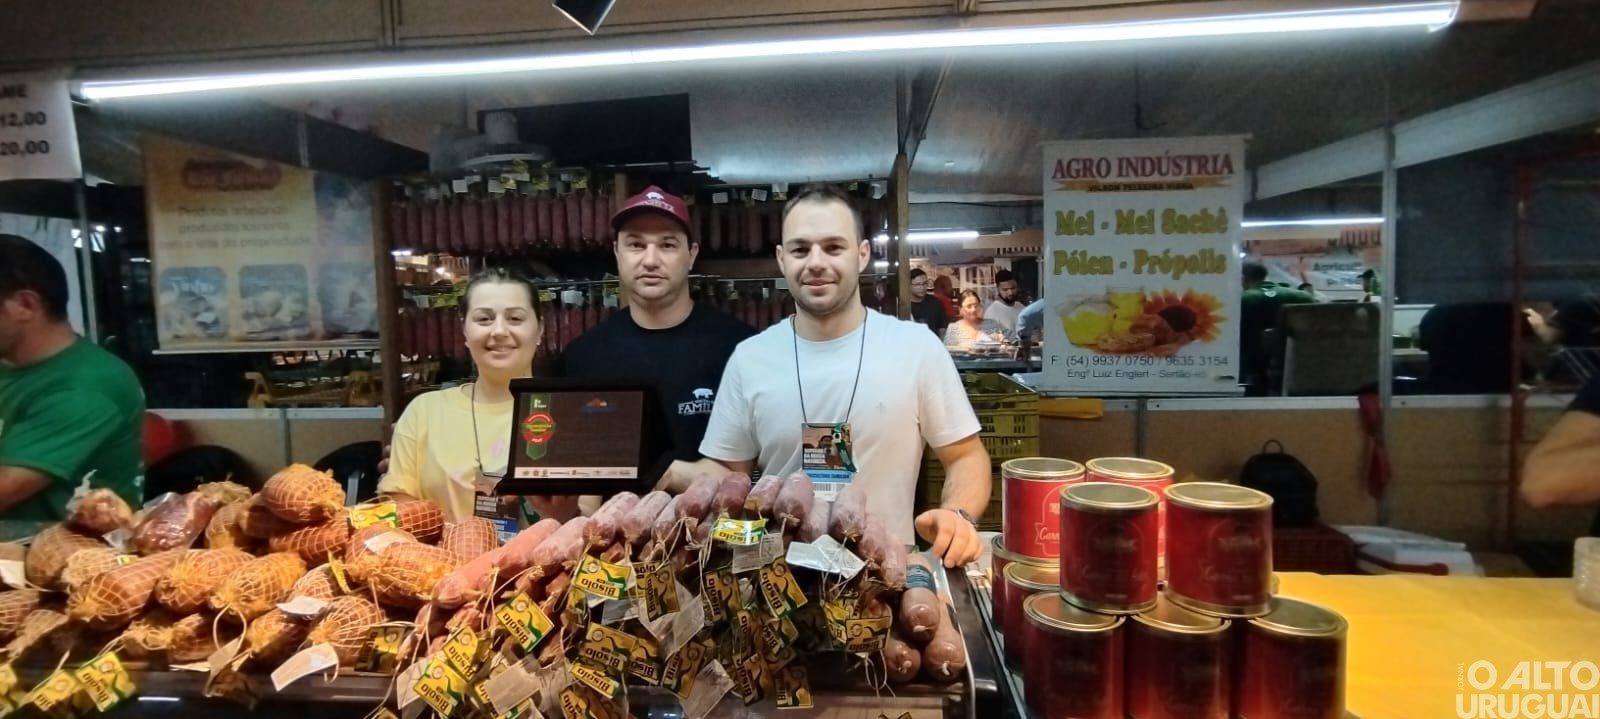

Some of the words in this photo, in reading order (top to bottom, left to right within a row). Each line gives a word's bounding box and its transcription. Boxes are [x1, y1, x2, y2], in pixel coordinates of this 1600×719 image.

[1052, 157, 1111, 180] AGRO
[1117, 150, 1234, 178] INDÚSTRIA
[1055, 210, 1095, 236] Mel
[1114, 209, 1156, 235] Mel
[1161, 206, 1229, 234] Sachê
[1053, 249, 1114, 275] Pólen
[1133, 248, 1227, 279] Própolis
[1066, 356, 1089, 367] (54)
[1092, 355, 1121, 366] 9937
[1125, 355, 1154, 366] 0750
[1199, 355, 1229, 366] 3154
[580, 578, 617, 597] Bisolo
[761, 571, 783, 610] Bisolo
[502, 612, 530, 645] Bisolo
[448, 646, 476, 678] Bisolo
[585, 647, 620, 668] Bisolo
[577, 667, 611, 692] Bisolo
[420, 683, 450, 712] Bisolo
